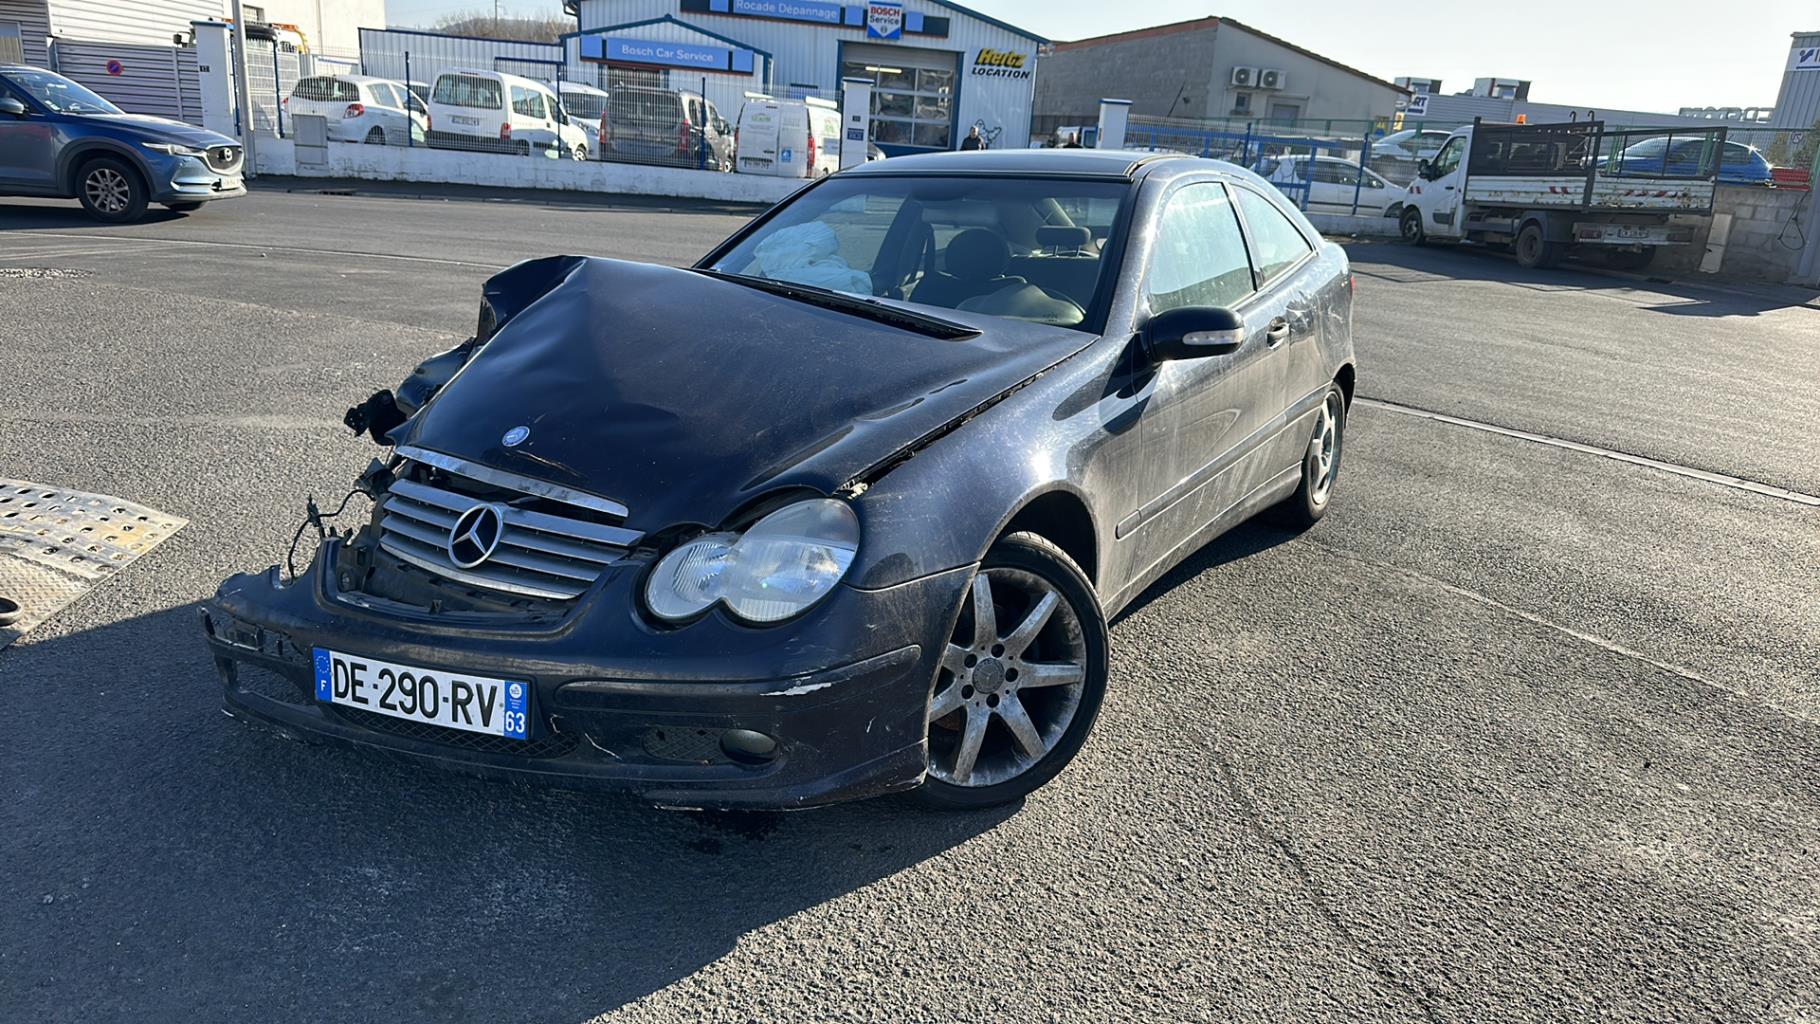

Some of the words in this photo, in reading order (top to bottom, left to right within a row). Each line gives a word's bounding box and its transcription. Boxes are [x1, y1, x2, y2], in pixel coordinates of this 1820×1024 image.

[736, 0, 776, 12] Rocade
[779, 2, 837, 18] Dépannage
[870, 6, 901, 16] BOSCH
[869, 15, 899, 25] Service
[622, 44, 654, 56] Bosch
[656, 47, 674, 58] Car
[676, 49, 713, 62] Service
[974, 47, 1025, 69] Hertz
[971, 67, 1031, 79] LOCATION
[320, 679, 327, 691] F
[333, 658, 498, 728] DE-290-RV
[505, 710, 526, 734] 63
